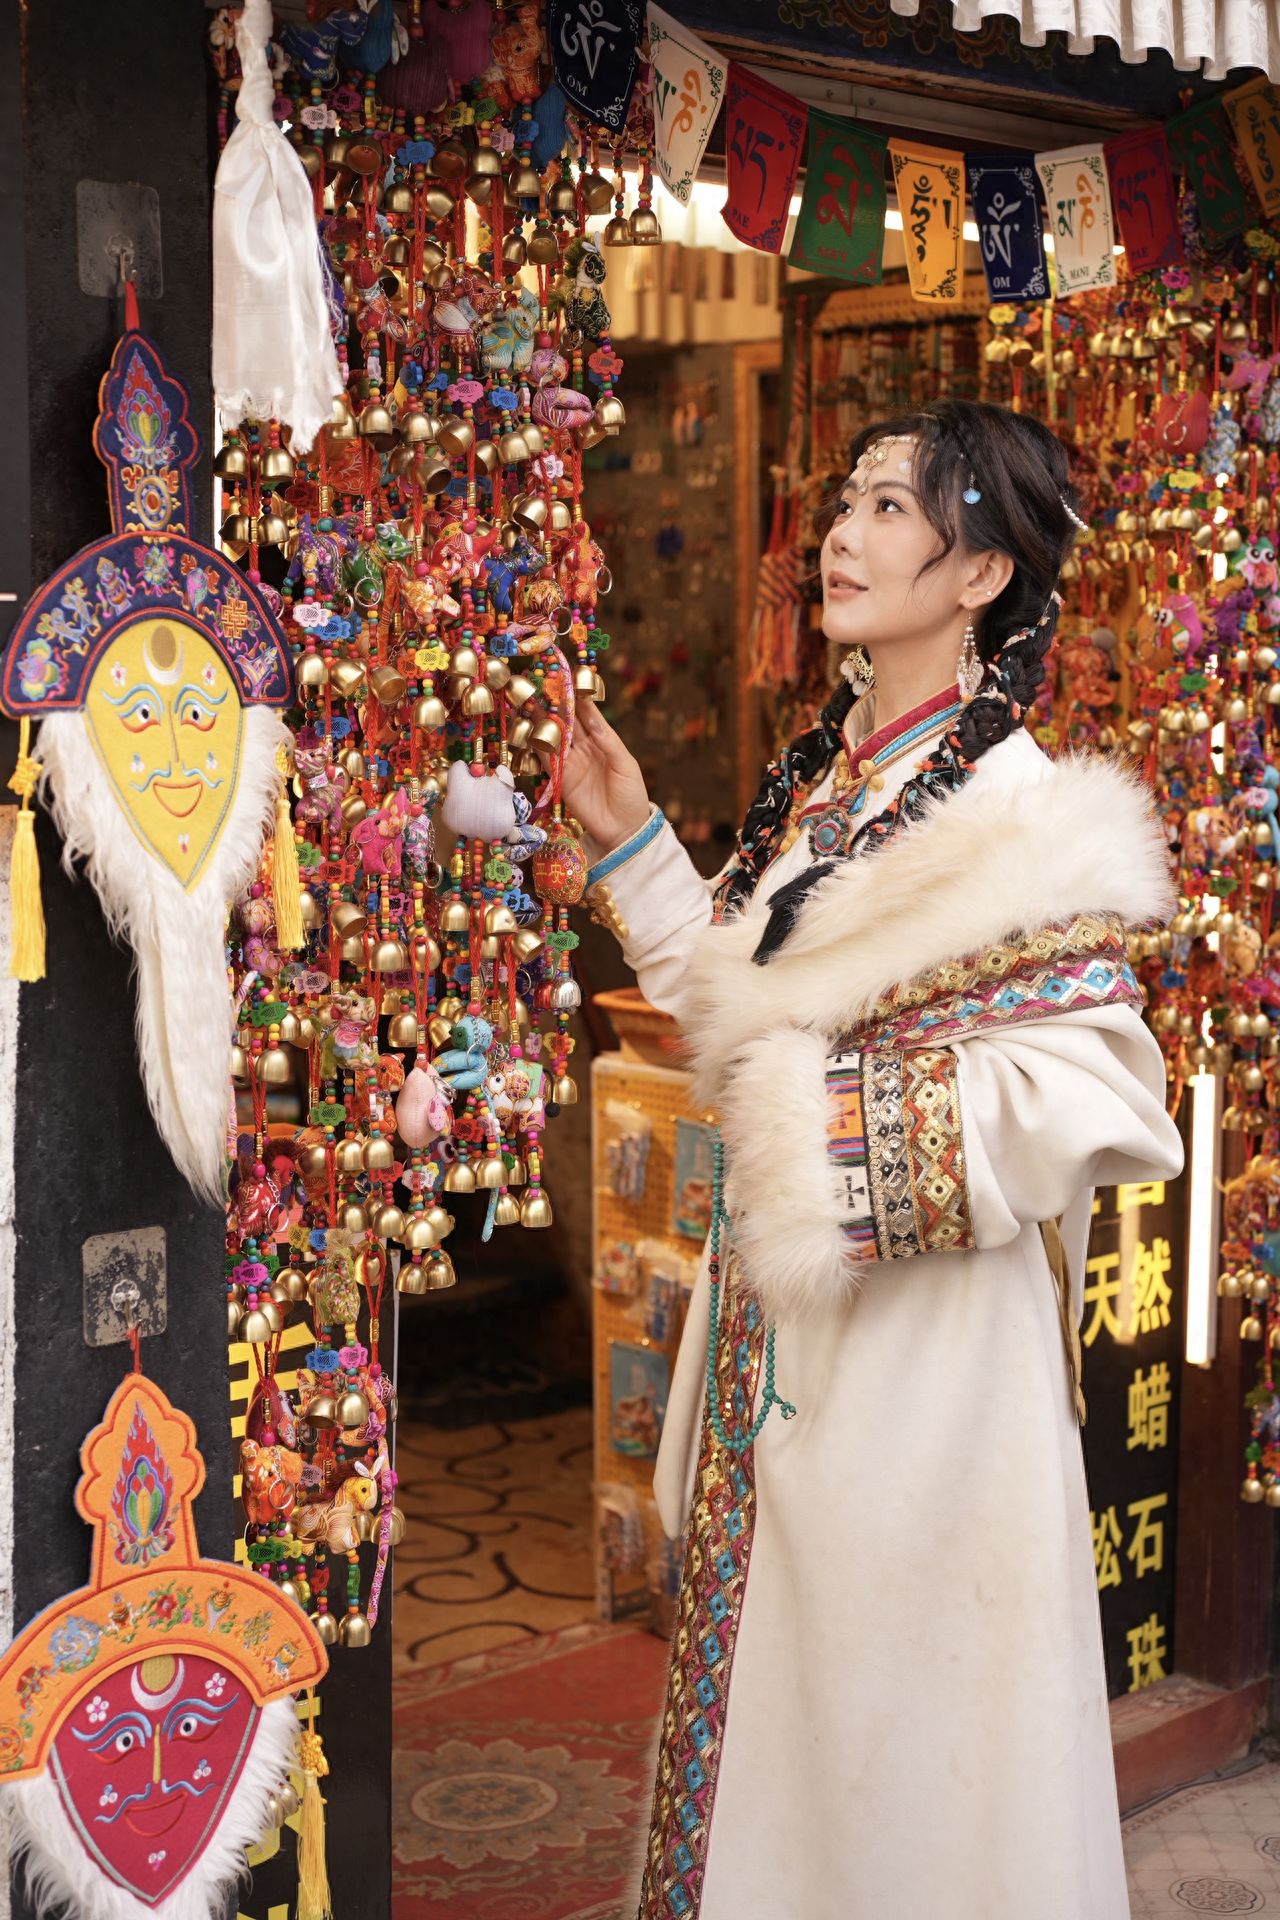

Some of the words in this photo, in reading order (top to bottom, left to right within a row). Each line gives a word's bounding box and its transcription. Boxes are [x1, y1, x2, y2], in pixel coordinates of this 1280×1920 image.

[566, 75, 588, 97] OM
[732, 209, 750, 229] PAE
[993, 276, 1011, 288] OM
[1069, 265, 1089, 281] MANI
[535, 861, 566, 887] 平安
[1083, 1237, 1173, 1348] 天然
[1128, 1361, 1172, 1451] 蜡
[1089, 1492, 1168, 1590] 松石
[1126, 1612, 1168, 1693] 珠
